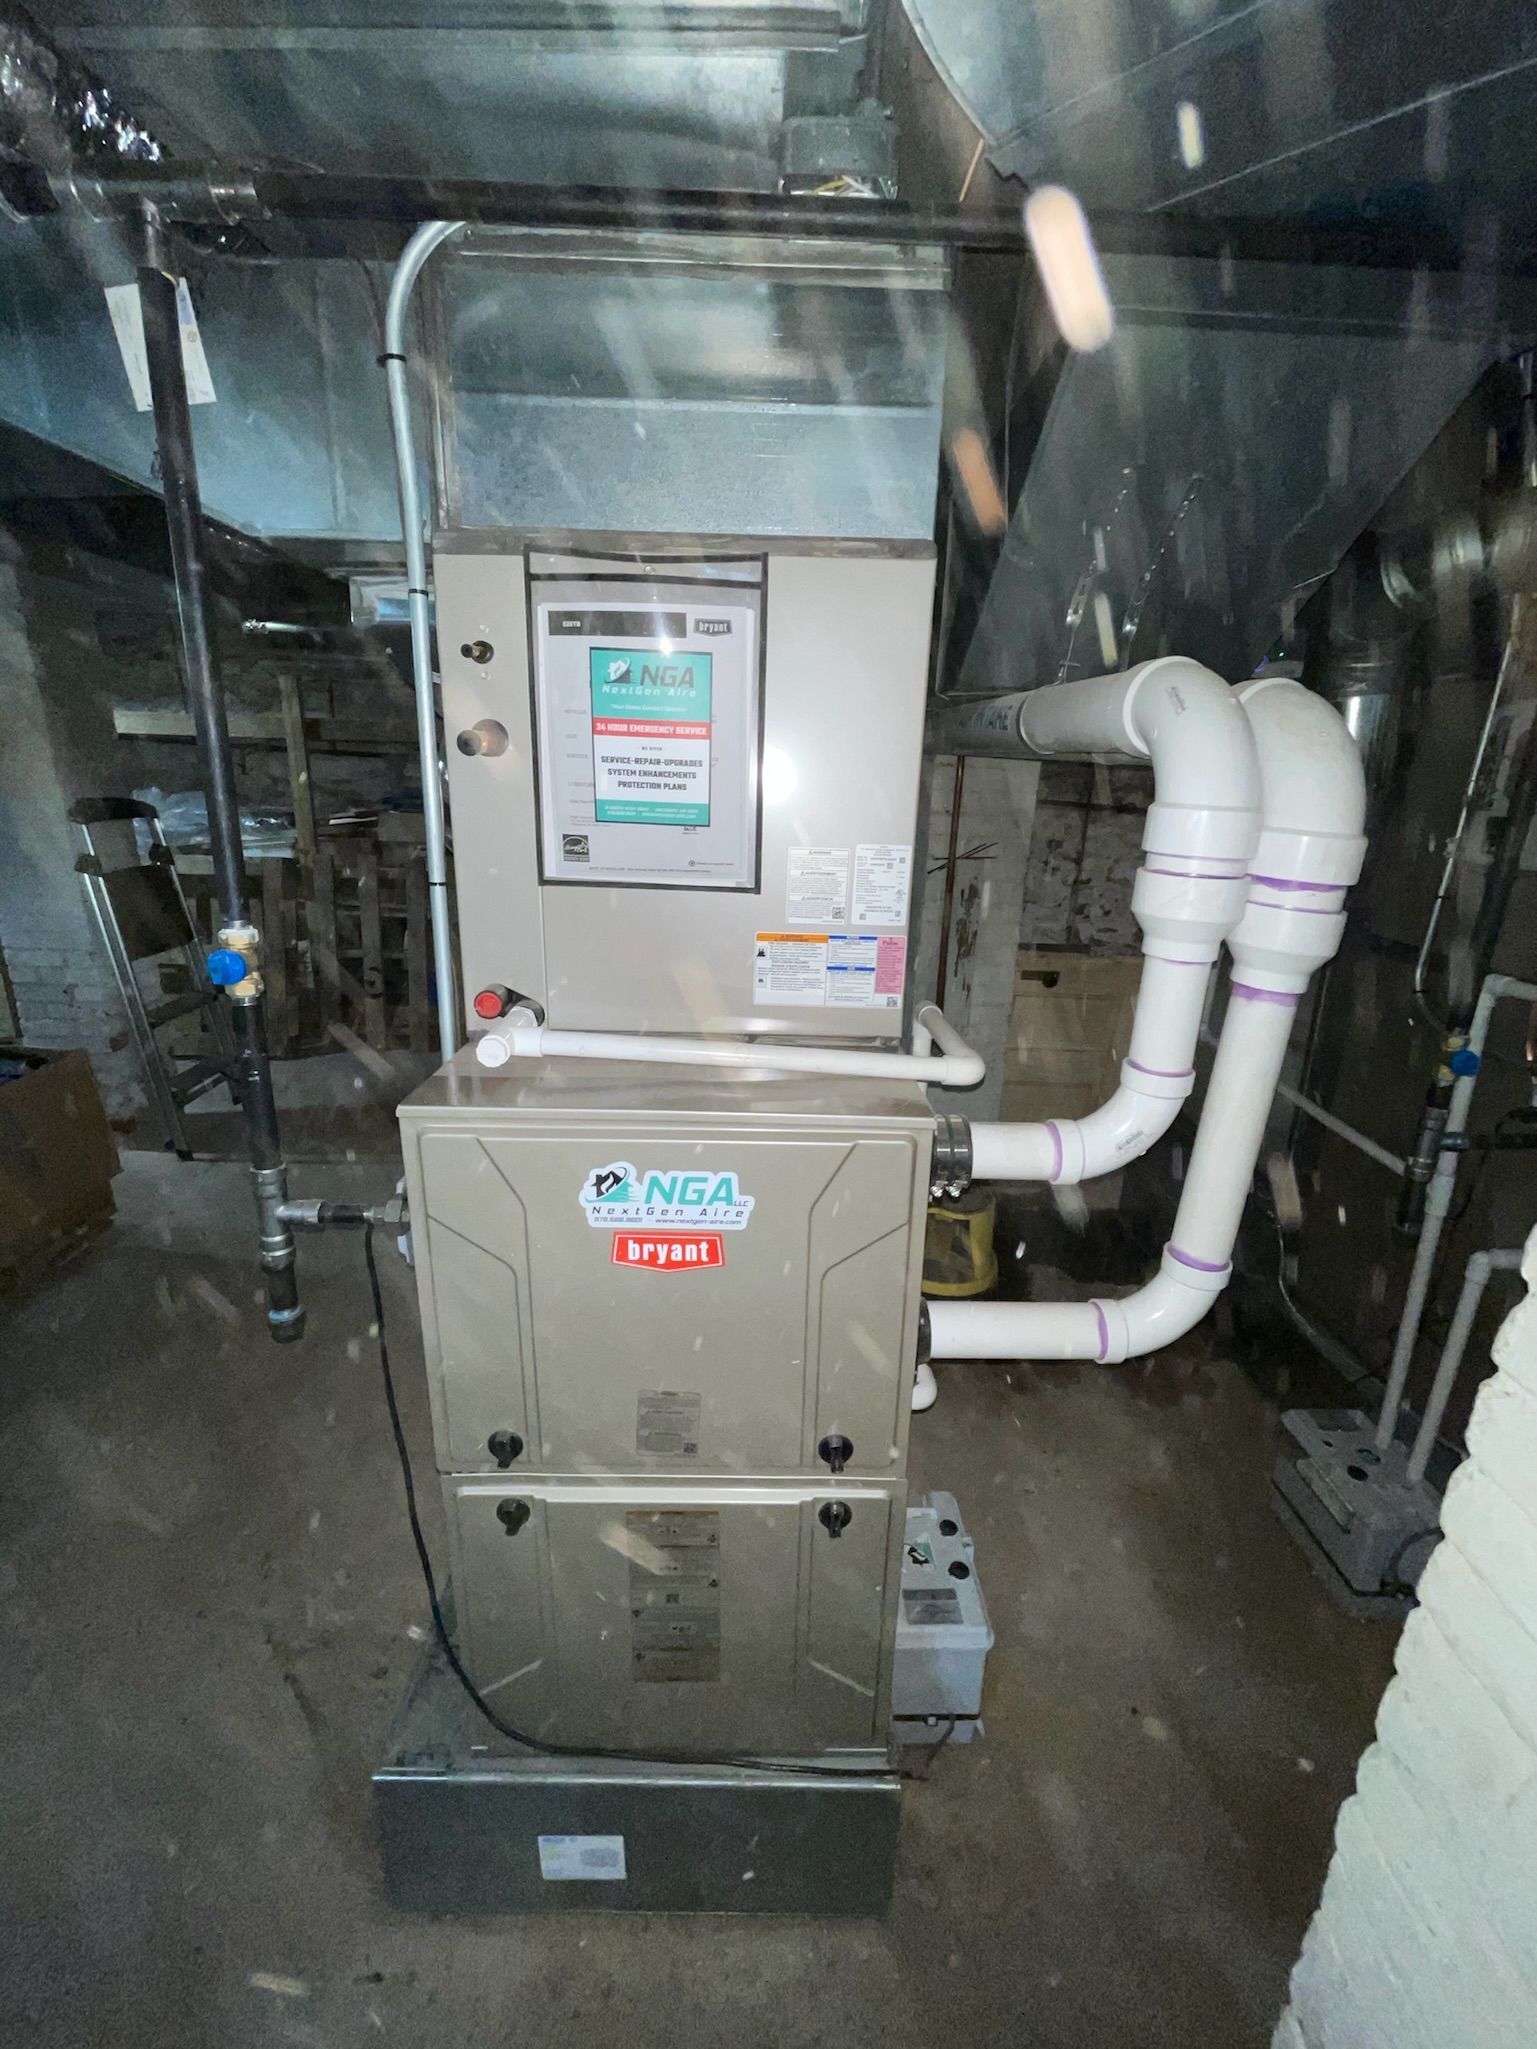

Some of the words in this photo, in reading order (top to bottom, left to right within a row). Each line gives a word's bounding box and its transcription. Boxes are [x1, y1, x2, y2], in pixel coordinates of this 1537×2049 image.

[698, 621, 729, 634] bryant
[640, 665, 695, 688] NGA
[596, 723, 606, 731] 24
[607, 723, 628, 732] HOUR
[629, 724, 674, 734] EMERGENCY
[675, 726, 707, 735] SERVICE
[601, 755, 704, 767] SERVICE-REPAIR-UPGRADES
[607, 768, 637, 777] SYSTEM
[638, 769, 697, 779] ENHANCEMENTS
[617, 780, 662, 790] PROTECTION
[663, 782, 687, 791] PLANS
[644, 1175, 734, 1206] NGA
[592, 1206, 684, 1216] NextGen
[699, 1207, 745, 1218] Aire
[655, 1218, 742, 1226] www.nextgen-aire.com
[627, 1240, 709, 1264] bryant
